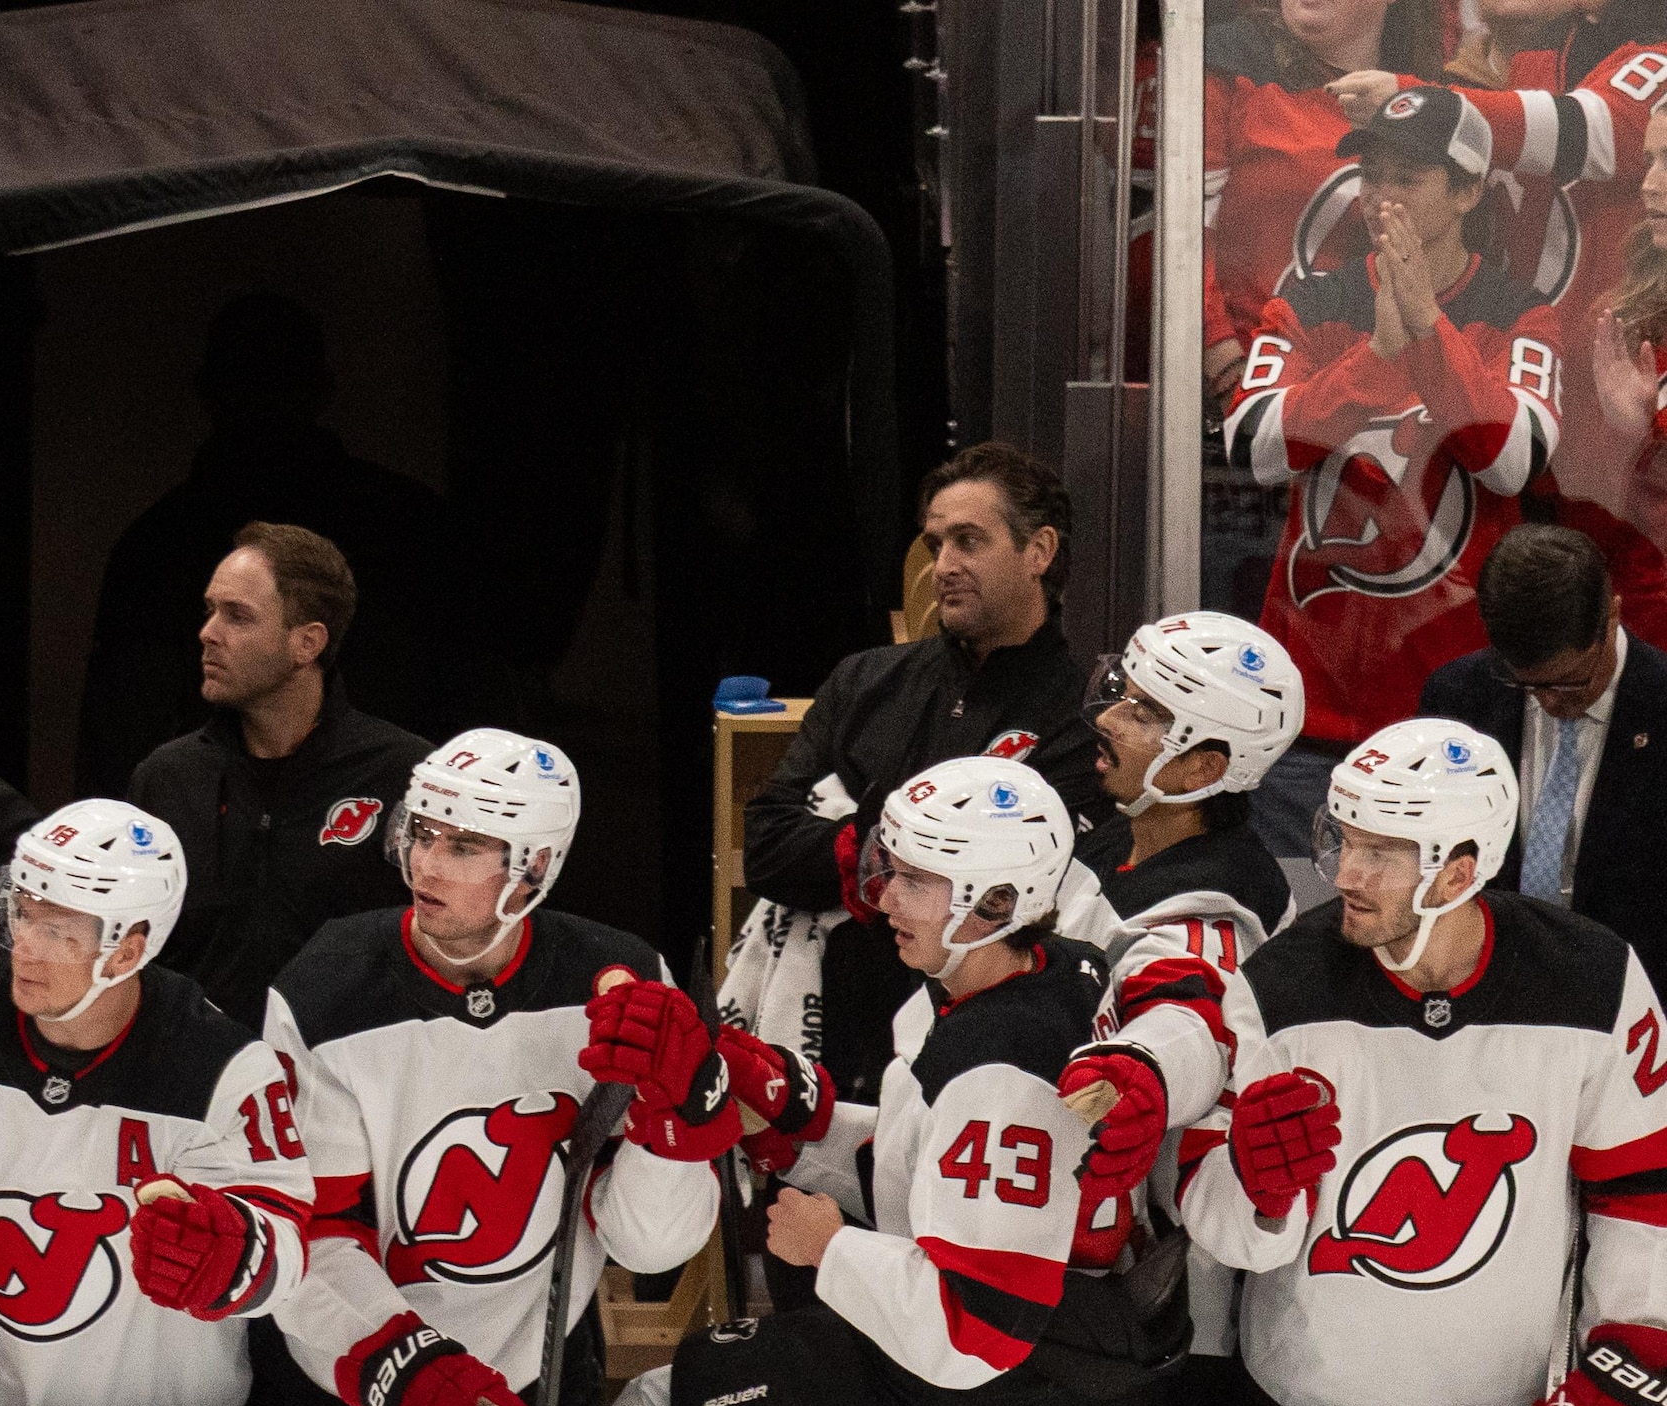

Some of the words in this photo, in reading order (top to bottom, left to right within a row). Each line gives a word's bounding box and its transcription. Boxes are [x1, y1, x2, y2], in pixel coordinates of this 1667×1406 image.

[1241, 335, 1292, 390] 6
[117, 1116, 158, 1188] A
[237, 1080, 308, 1164] 18
[938, 1119, 1054, 1210] 43
